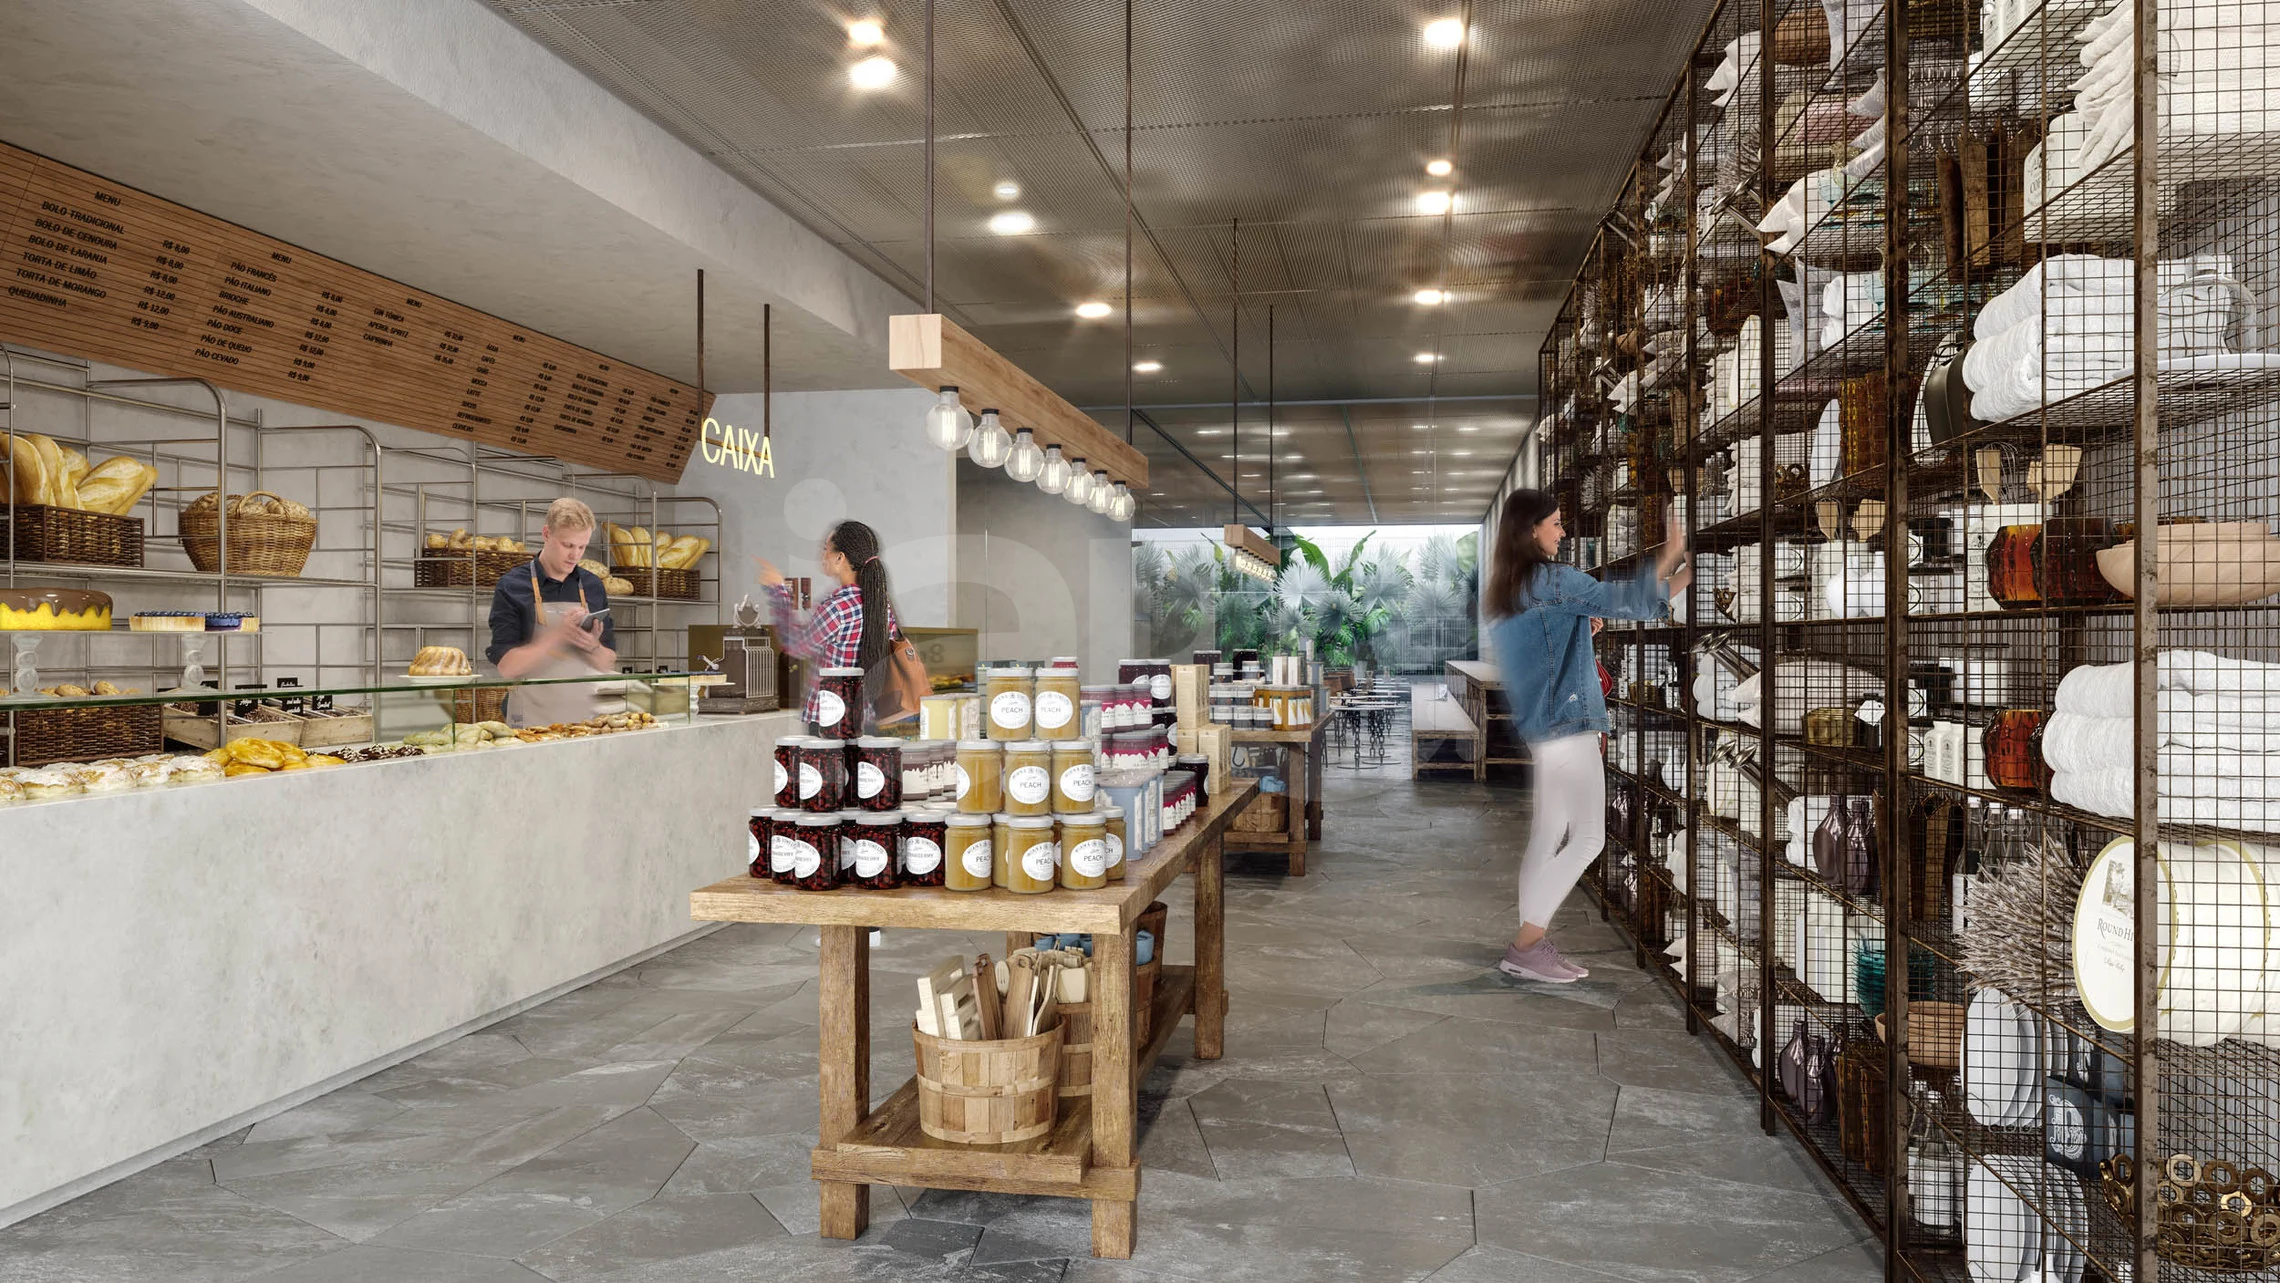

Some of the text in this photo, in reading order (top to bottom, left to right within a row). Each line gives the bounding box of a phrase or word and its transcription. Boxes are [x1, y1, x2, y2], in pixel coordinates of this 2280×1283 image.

[94, 191, 122, 207] MENU
[41, 201, 126, 234] BOLO TRADICIONAL
[34, 218, 118, 250] BOLO DE CENOURA
[28, 235, 108, 265] BOLO DE LARANJA
[162, 240, 173, 249] R$
[23, 252, 52, 267] TORTA
[54, 261, 67, 271] DE
[156, 255, 167, 265] R$
[271, 252, 292, 264] MENU
[150, 270, 161, 280] R$
[16, 268, 107, 299] TORTA DE MORANGO
[144, 286, 154, 295] R$
[240, 281, 272, 297] ITALIANO
[137, 301, 148, 309] R$
[218, 291, 250, 305] BRIOCHE
[131, 317, 141, 326] R$
[228, 309, 275, 329] AUSTRALIANO
[222, 323, 244, 335] DOCE
[217, 339, 226, 348] DE
[701, 417, 775, 478] CAIXA
